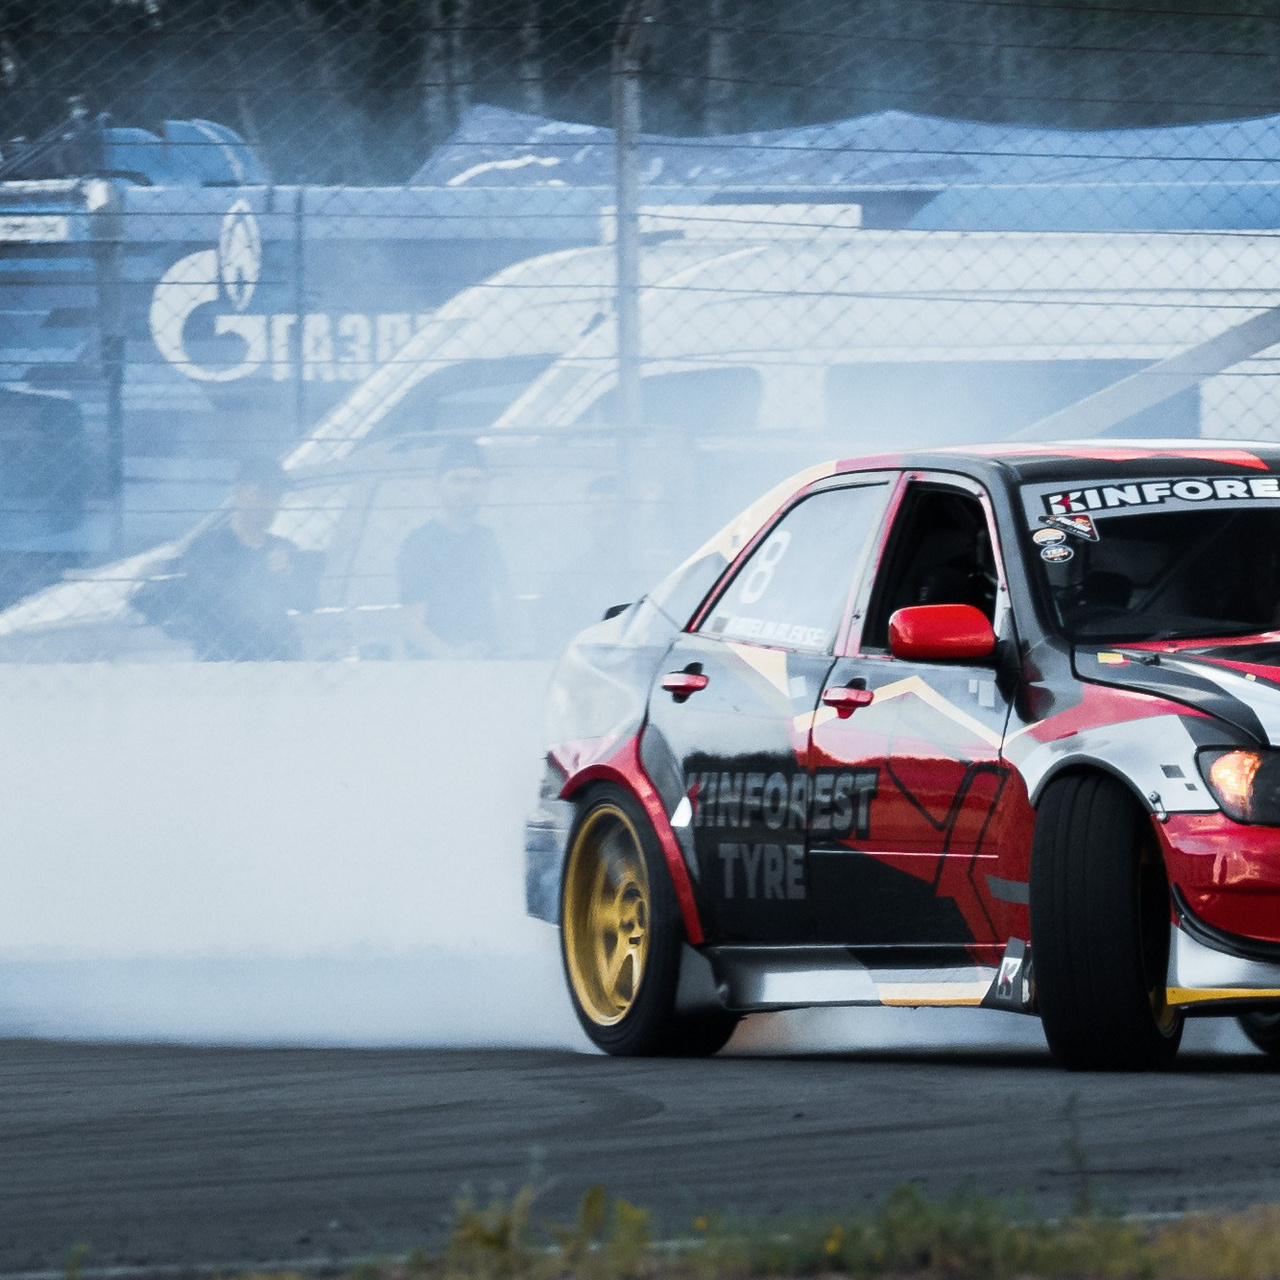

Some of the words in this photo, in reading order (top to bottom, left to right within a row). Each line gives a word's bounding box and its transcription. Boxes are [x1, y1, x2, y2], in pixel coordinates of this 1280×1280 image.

[739, 530, 792, 605] 8
[685, 771, 878, 830] KINFOREST
[718, 842, 806, 900] TYRE
